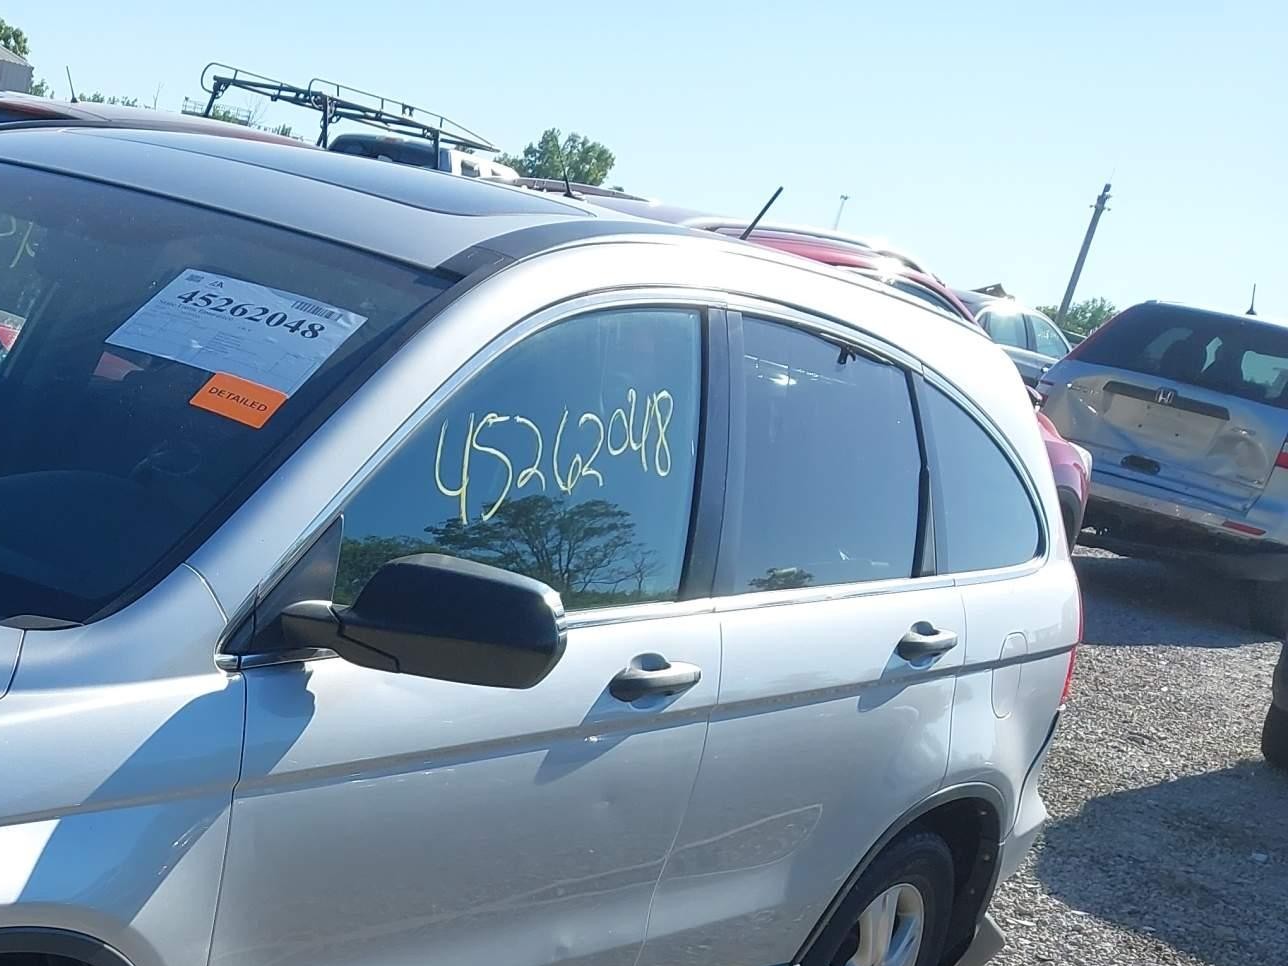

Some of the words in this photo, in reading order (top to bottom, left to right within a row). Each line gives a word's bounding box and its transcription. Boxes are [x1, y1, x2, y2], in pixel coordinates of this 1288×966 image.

[177, 289, 325, 339] 45262048
[208, 386, 268, 413] DETAILED
[435, 388, 673, 524] 45262048
